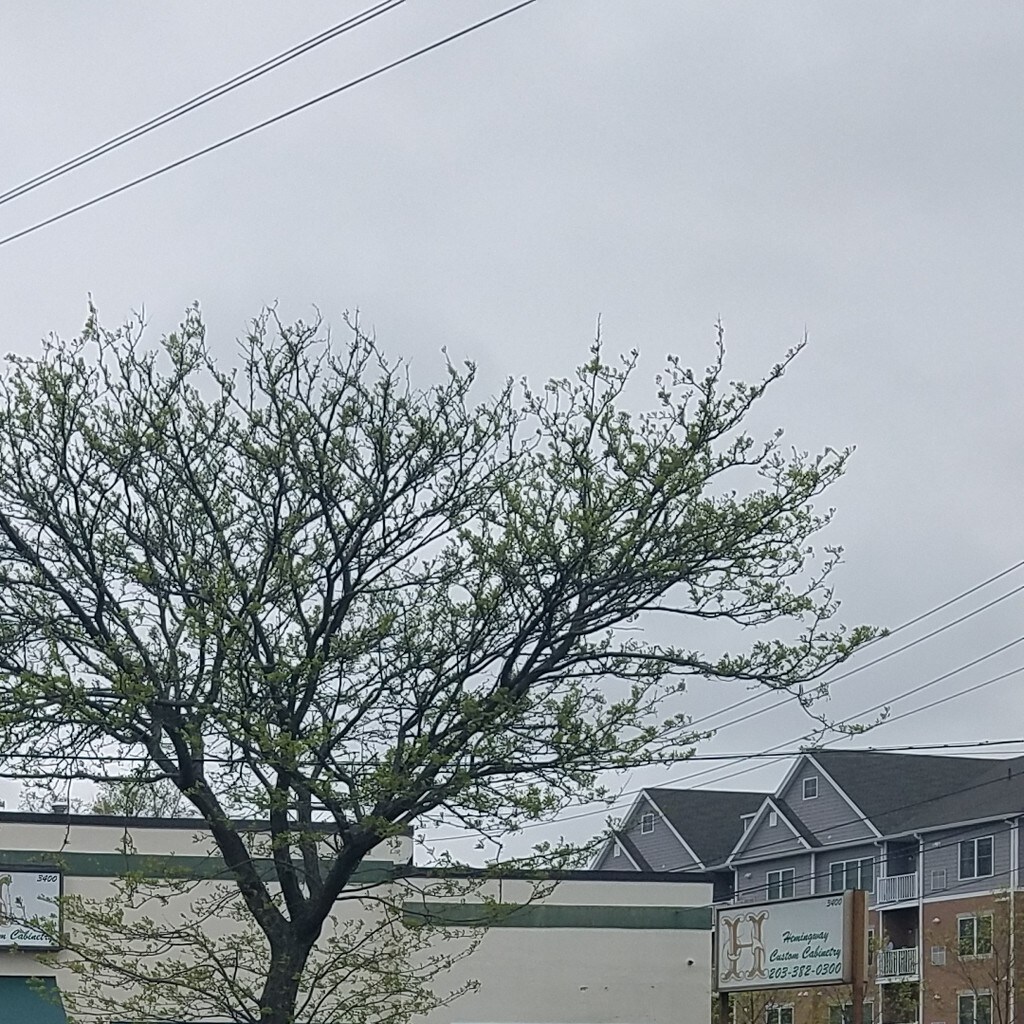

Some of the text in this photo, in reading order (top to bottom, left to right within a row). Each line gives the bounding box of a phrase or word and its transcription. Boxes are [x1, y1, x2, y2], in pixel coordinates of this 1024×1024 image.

[36, 874, 58, 883] 3400
[826, 898, 843, 908] 3400
[782, 931, 829, 944] Hemingway
[721, 910, 769, 982] H
[769, 946, 842, 962] Custom Cabinetry
[768, 963, 842, 979] 203-382-0300
